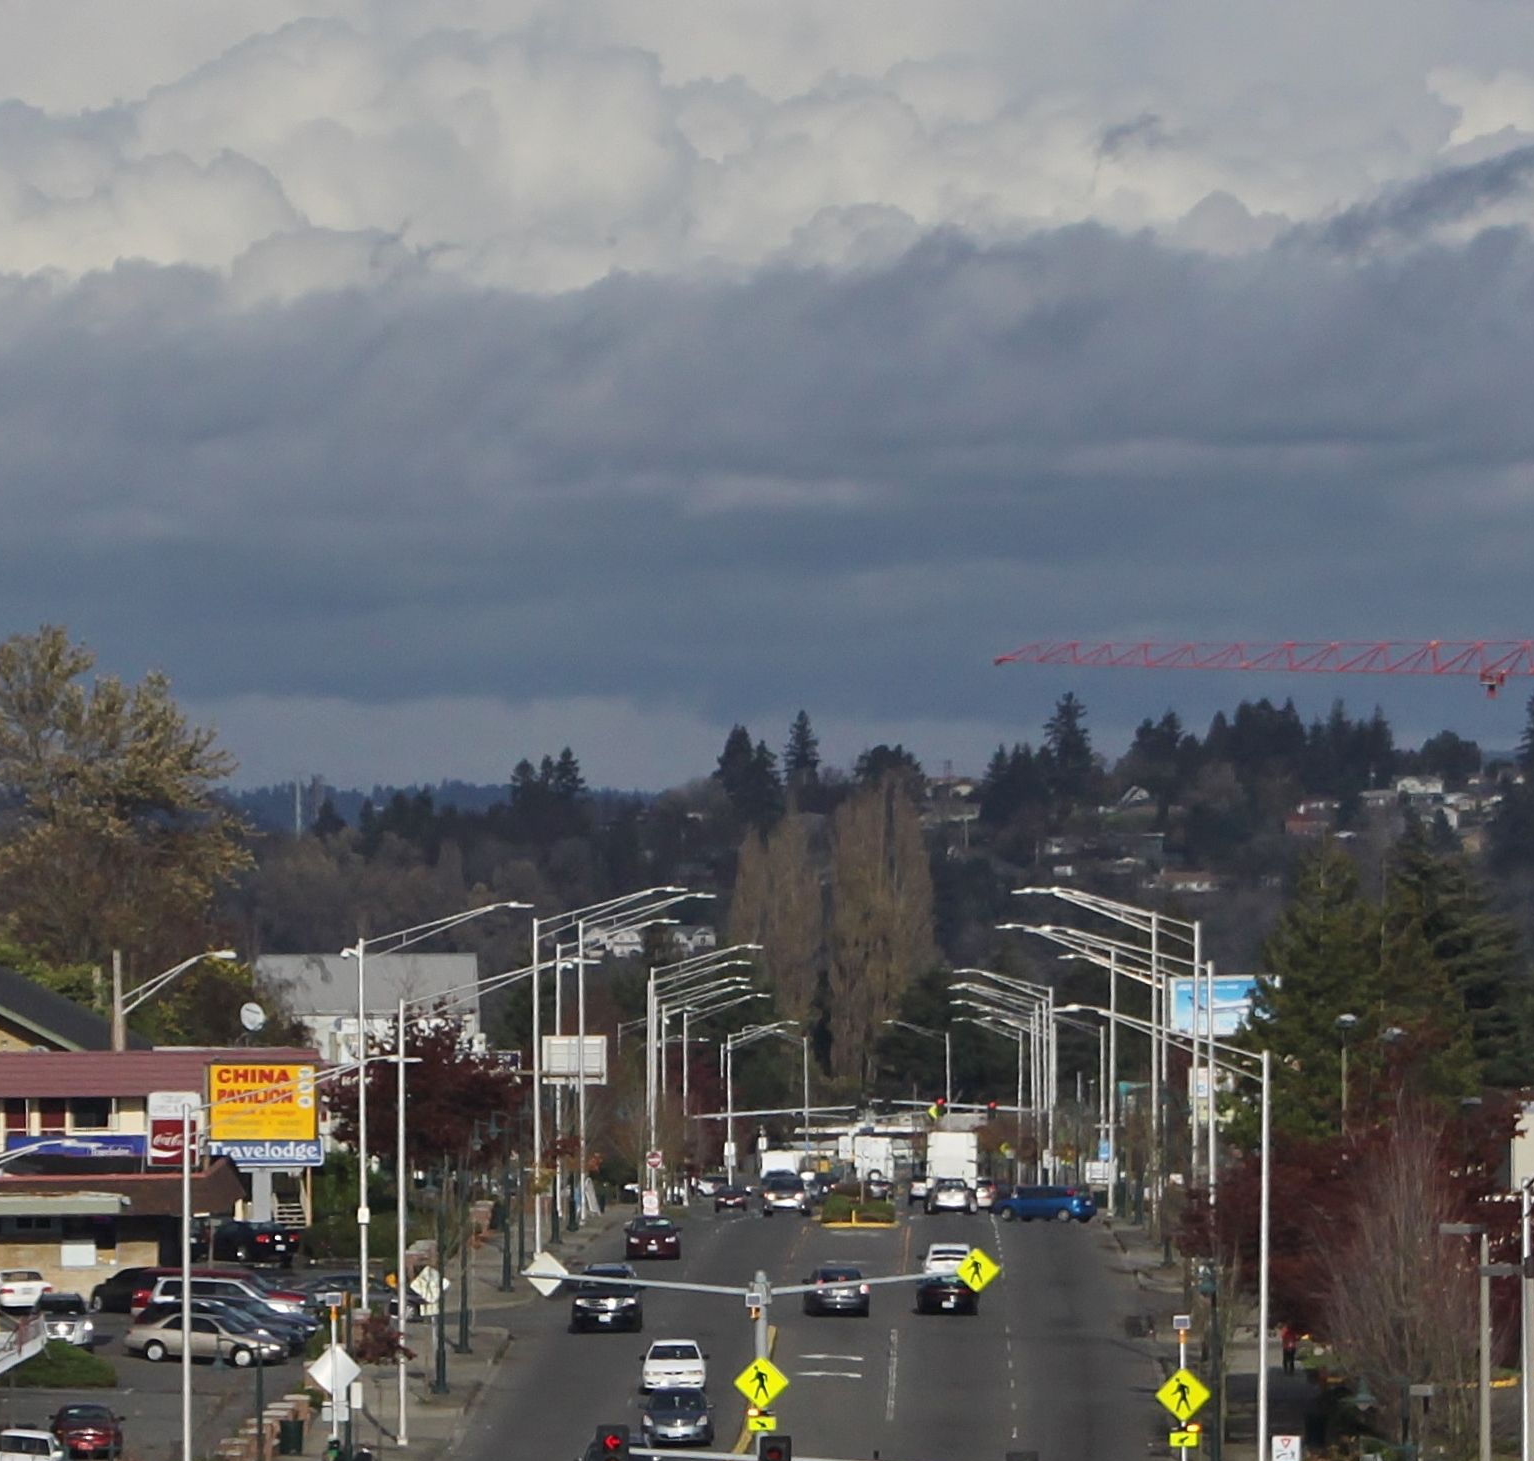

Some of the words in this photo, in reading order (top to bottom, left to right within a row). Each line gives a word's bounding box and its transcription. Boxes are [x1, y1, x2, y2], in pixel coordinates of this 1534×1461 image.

[217, 1069, 291, 1084] CHINA
[217, 1089, 294, 1104] PAVILION
[208, 1141, 318, 1161] Travelodge
